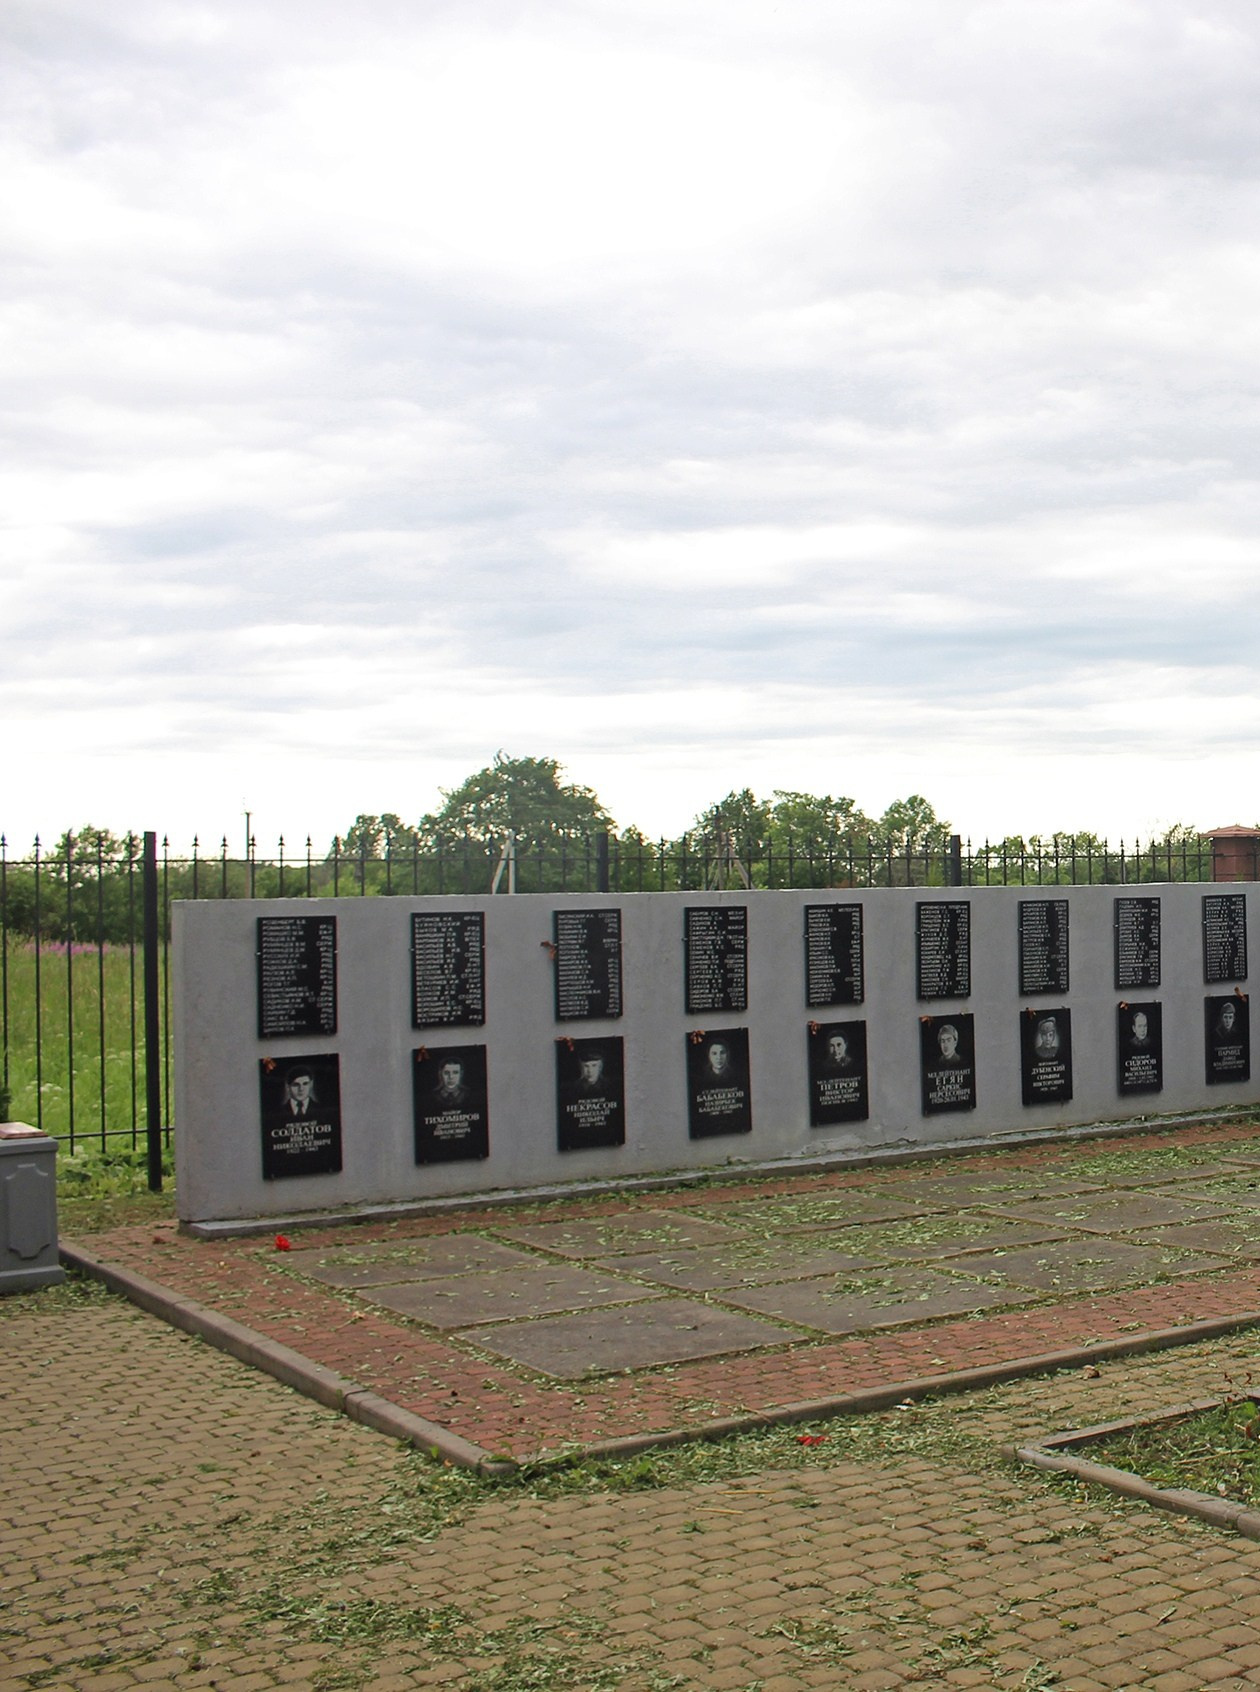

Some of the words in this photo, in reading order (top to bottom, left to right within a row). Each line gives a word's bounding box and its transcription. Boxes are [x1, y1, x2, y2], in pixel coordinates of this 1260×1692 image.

[1125, 1059, 1157, 1067] СИДОРОВ
[820, 1081, 858, 1091] ПЕТРОВ
[935, 1075, 963, 1086] ЕГЯН
[566, 1101, 617, 1112] НЕКРАСОВ
[424, 1113, 480, 1125] ТИХОМИРОВ
[271, 1124, 332, 1137] СОЛДАТОВ
